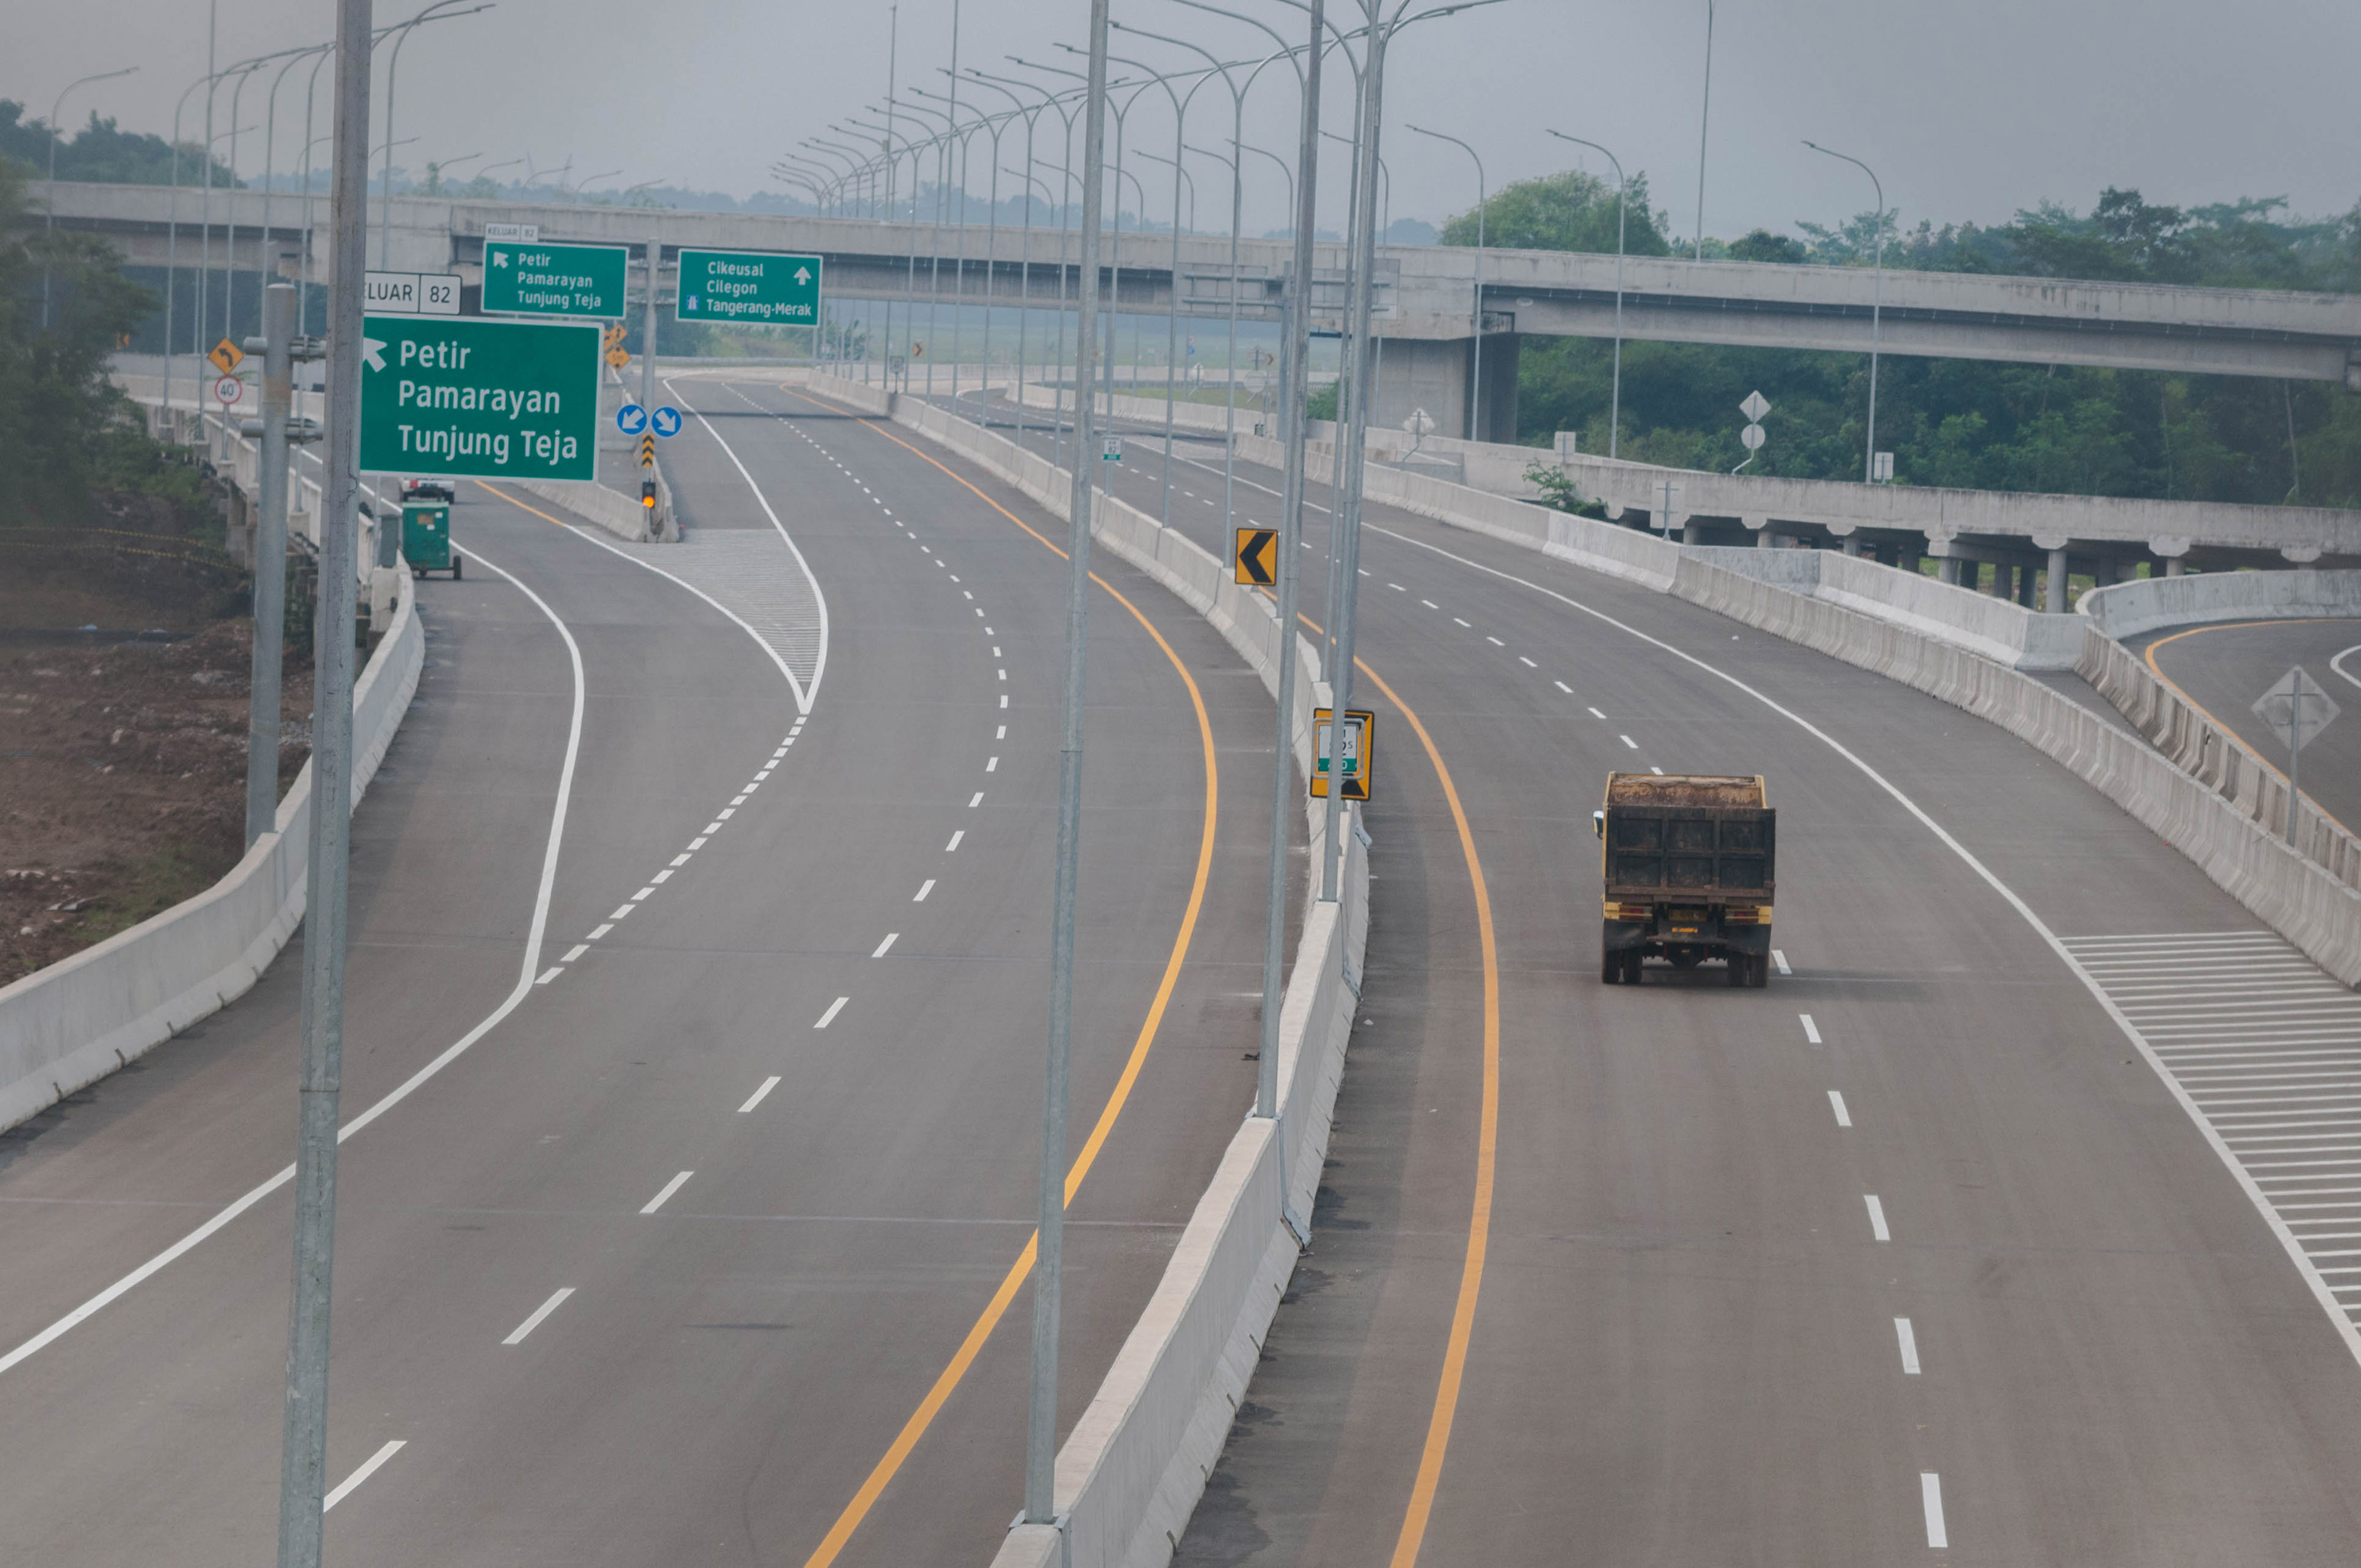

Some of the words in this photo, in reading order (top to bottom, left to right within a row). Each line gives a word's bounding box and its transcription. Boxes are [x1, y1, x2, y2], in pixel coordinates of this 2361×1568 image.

[488, 227, 518, 236] KELUAR
[525, 228, 535, 237] 82
[518, 253, 551, 266] Petir
[708, 261, 763, 277] Cikeusal
[518, 271, 593, 290] Pamarayan
[707, 280, 757, 297] Cilegon
[364, 282, 412, 301] LUAR
[430, 286, 450, 303] 82
[518, 290, 569, 309] Tunjung
[574, 294, 601, 310] Teja
[707, 299, 812, 318] Tangerang-Merak
[400, 341, 471, 369] Petir
[220, 384, 234, 397] 40
[398, 380, 560, 420] Pamarayan
[398, 424, 509, 464] Tunjung
[521, 430, 577, 465] Teja
